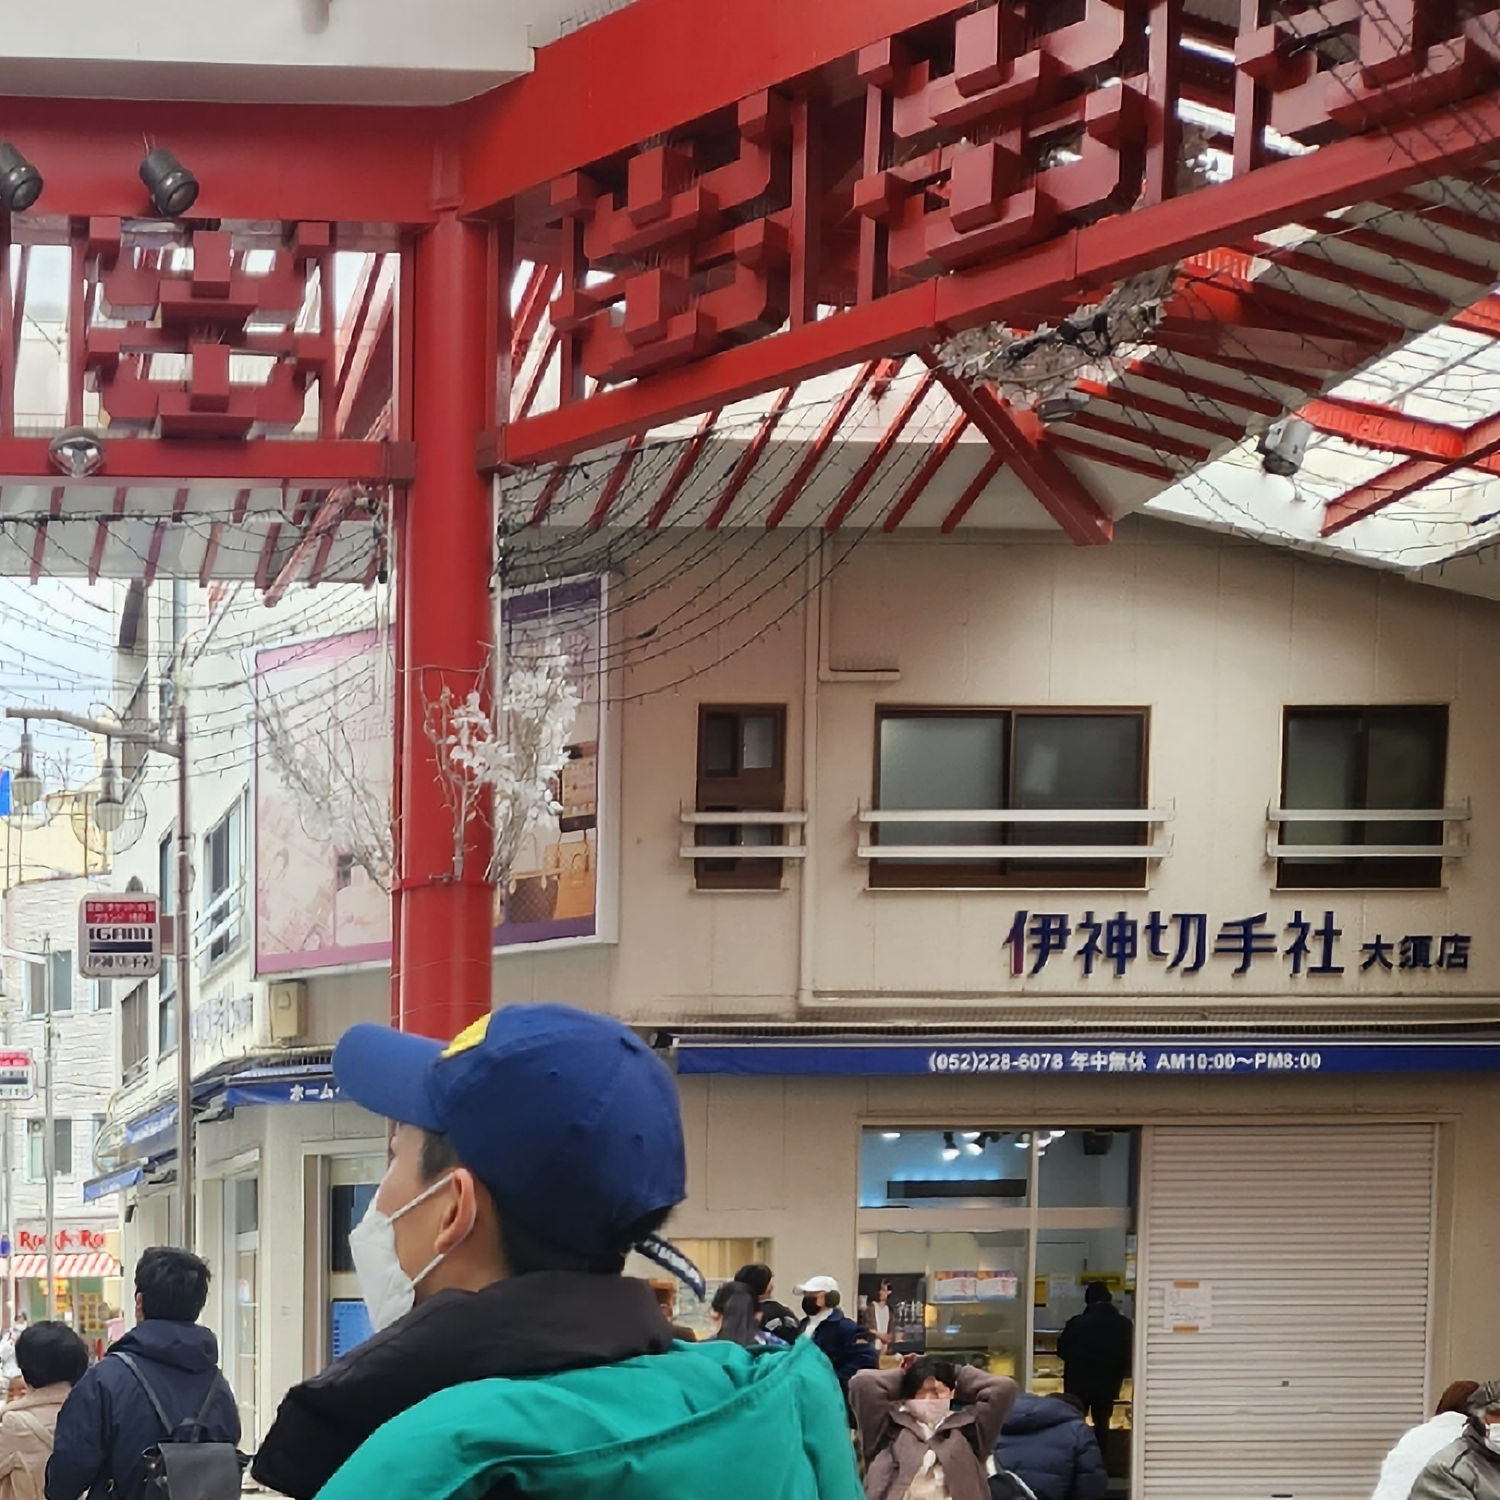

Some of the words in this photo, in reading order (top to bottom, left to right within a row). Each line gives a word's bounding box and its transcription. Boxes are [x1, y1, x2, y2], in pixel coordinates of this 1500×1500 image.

[89, 927, 153, 940] IGAMI
[1002, 909, 1346, 978] 伊神切手社
[1359, 933, 1472, 971] 大須店
[928, 1050, 1064, 1072] (052)228-6078
[1070, 1050, 1147, 1072] 年中無休
[290, 1082, 341, 1102] ホーム
